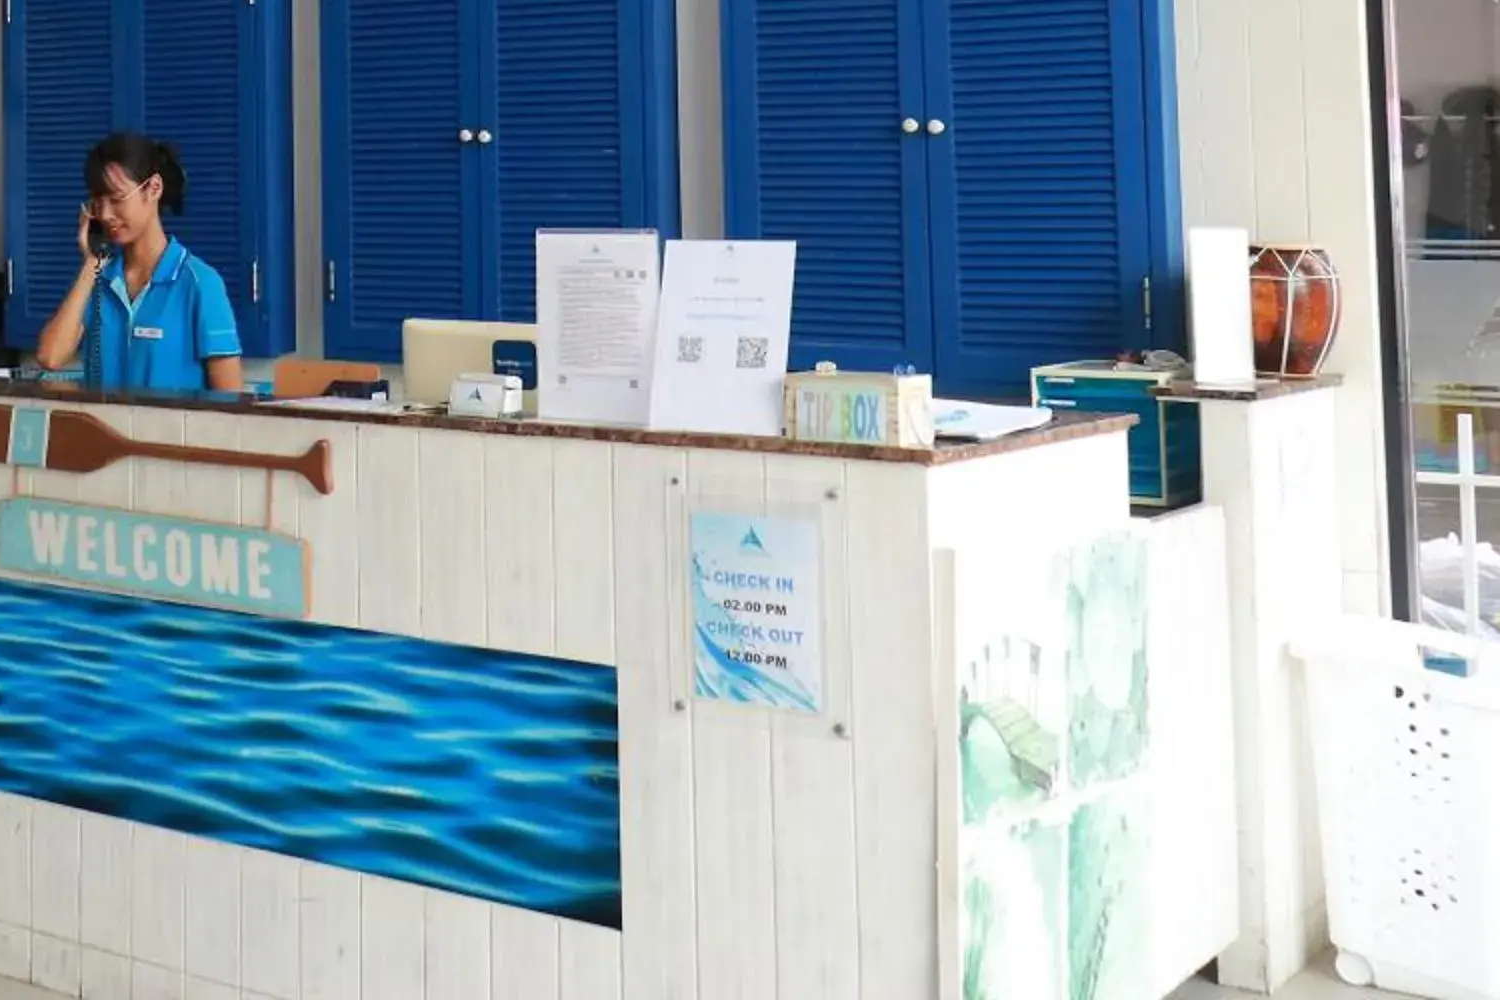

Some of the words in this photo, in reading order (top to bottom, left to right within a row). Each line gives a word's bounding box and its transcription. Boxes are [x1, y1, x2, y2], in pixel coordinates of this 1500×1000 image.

[803, 391, 832, 440] TIP
[840, 393, 881, 441] BOX
[28, 509, 273, 600] WELCOME
[713, 571, 770, 591] CHECK
[776, 577, 794, 594] IN
[723, 599, 761, 613] 02.00
[765, 603, 788, 616] PM
[706, 620, 764, 641] CHECK
[768, 629, 805, 645] OUT
[724, 650, 762, 665] 12.00
[766, 655, 788, 669] PM
